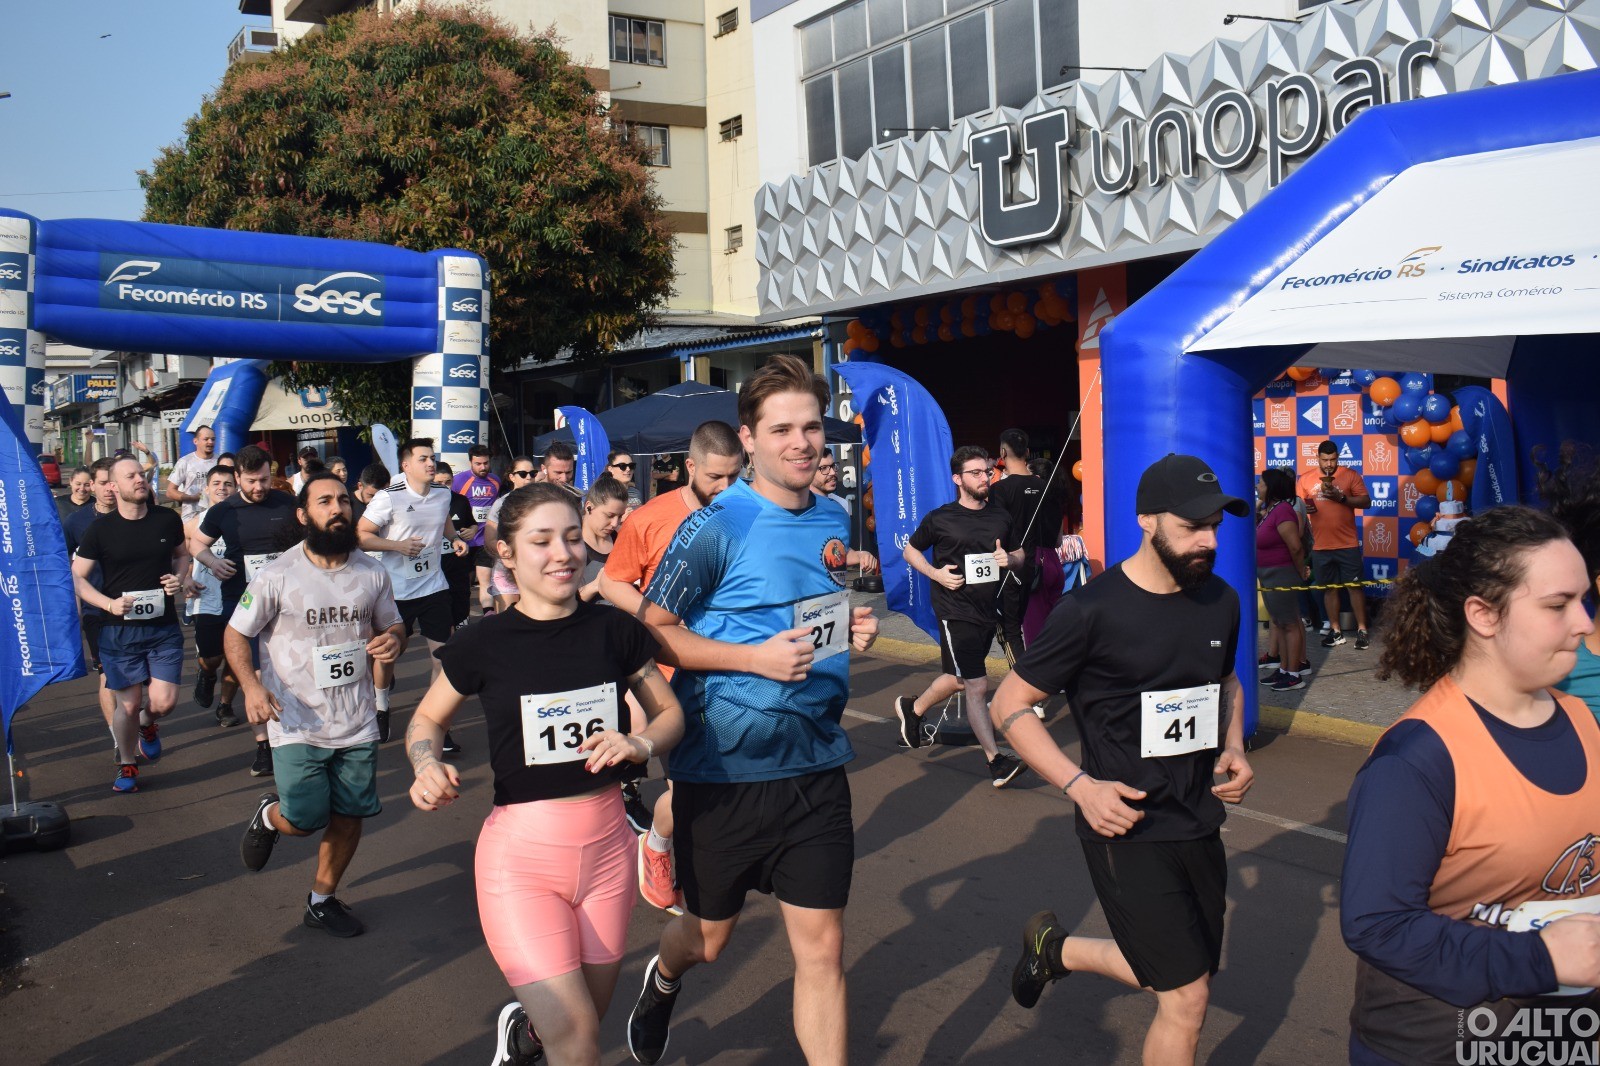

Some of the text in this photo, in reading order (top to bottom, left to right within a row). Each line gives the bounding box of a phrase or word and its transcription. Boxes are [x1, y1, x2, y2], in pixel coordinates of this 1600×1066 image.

[1091, 38, 1435, 194] unopar
[1458, 254, 1575, 274] Sindicatos
[1281, 262, 1426, 290] Fecomércio RS
[119, 284, 268, 310] Fecomércio RS
[293, 276, 382, 316] Sesc
[1438, 285, 1562, 302] Sistema Comércio
[452, 300, 478, 313] Sesc
[449, 366, 476, 379] Sesc
[415, 397, 436, 410] Sesc
[288, 411, 341, 425] unopa
[448, 431, 475, 444] Sesc
[1267, 459, 1295, 468] unopar
[1488, 463, 1503, 503] Sindicatos
[898, 468, 906, 520] Sindicatos
[1371, 500, 1397, 509] nopar
[18, 479, 36, 558] Sistema Comércio
[680, 519, 702, 546] BIKE
[414, 560, 429, 572] 61
[976, 566, 991, 578] 93
[7, 575, 19, 594] RS
[135, 603, 154, 615] 80
[802, 608, 822, 622] Sesc
[10, 599, 34, 677] Fecomércio
[811, 621, 836, 650] 27
[330, 661, 355, 680] 56
[538, 703, 572, 718] Sesc
[576, 698, 606, 707] Fecomércio
[1156, 700, 1183, 714] Sesc
[1164, 716, 1196, 742] 41
